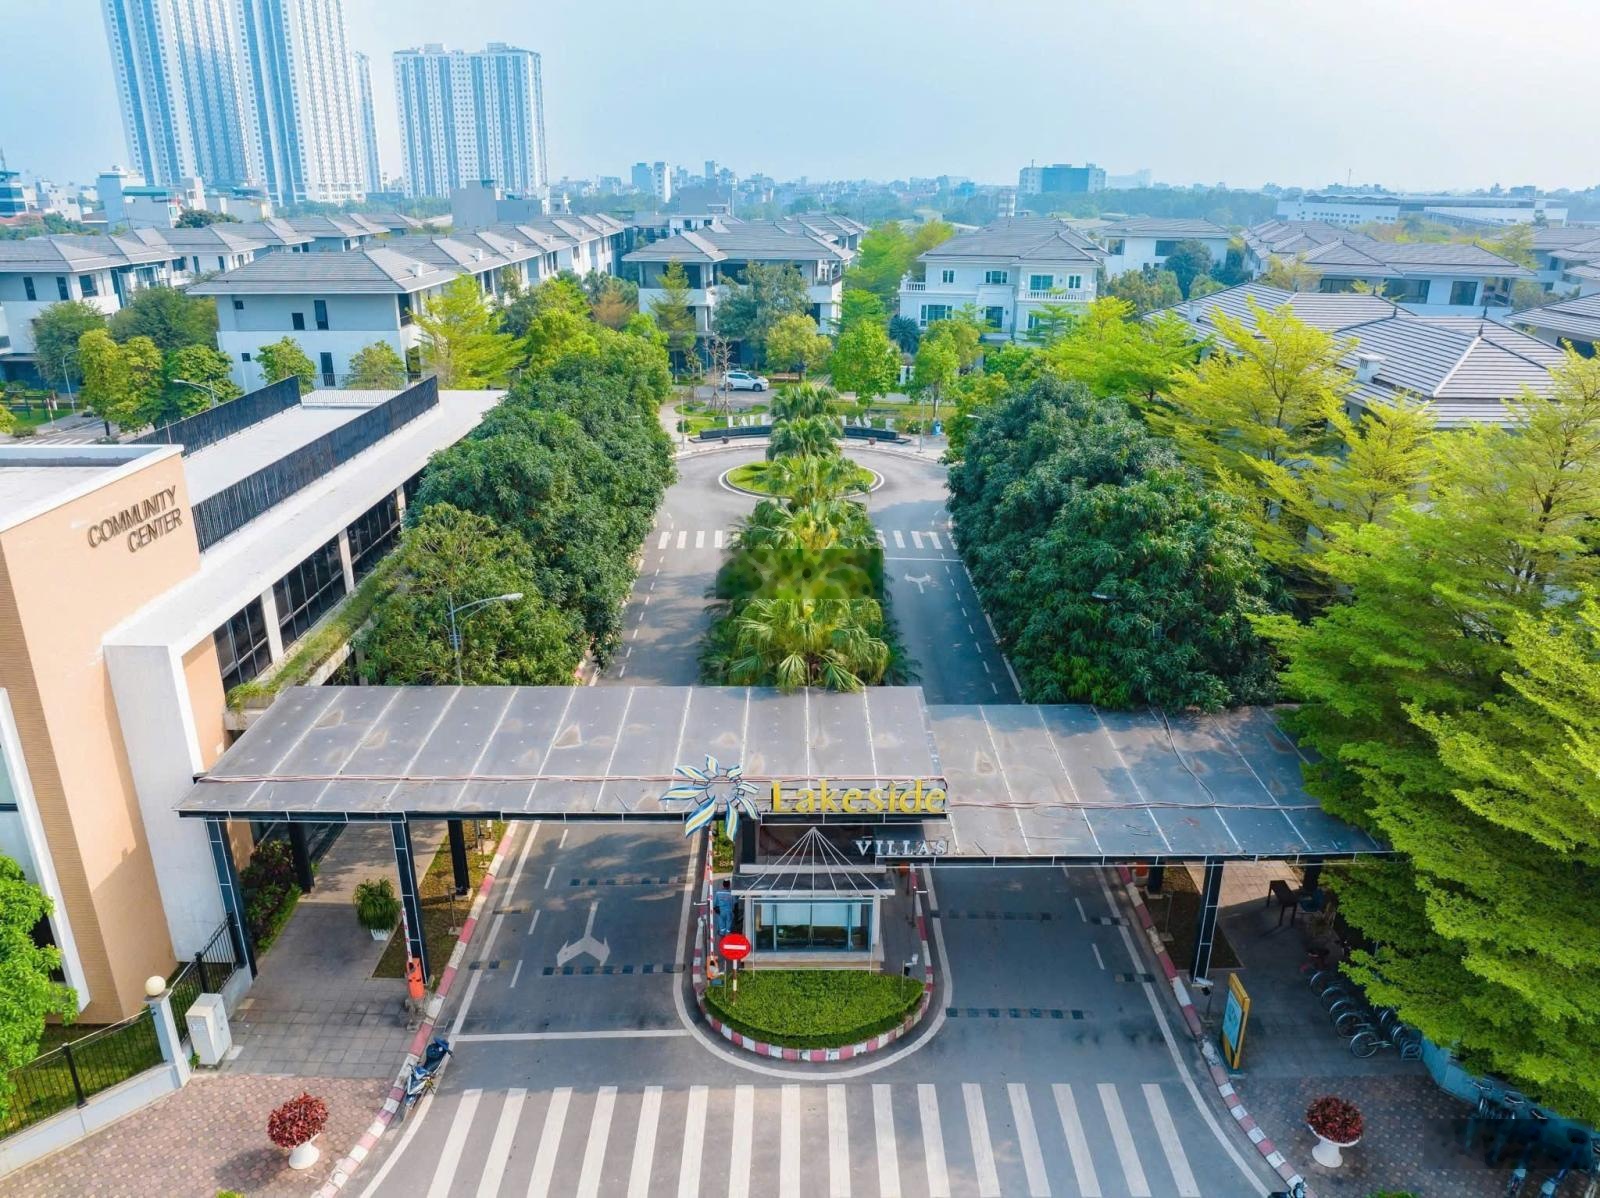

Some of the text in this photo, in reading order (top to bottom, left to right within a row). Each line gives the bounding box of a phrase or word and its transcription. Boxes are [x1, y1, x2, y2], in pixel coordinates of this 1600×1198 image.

[87, 485, 176, 548] COMMUNITY
[127, 508, 182, 553] CENTER
[771, 778, 947, 813] Lakeside
[855, 839, 946, 857] VILLAS
